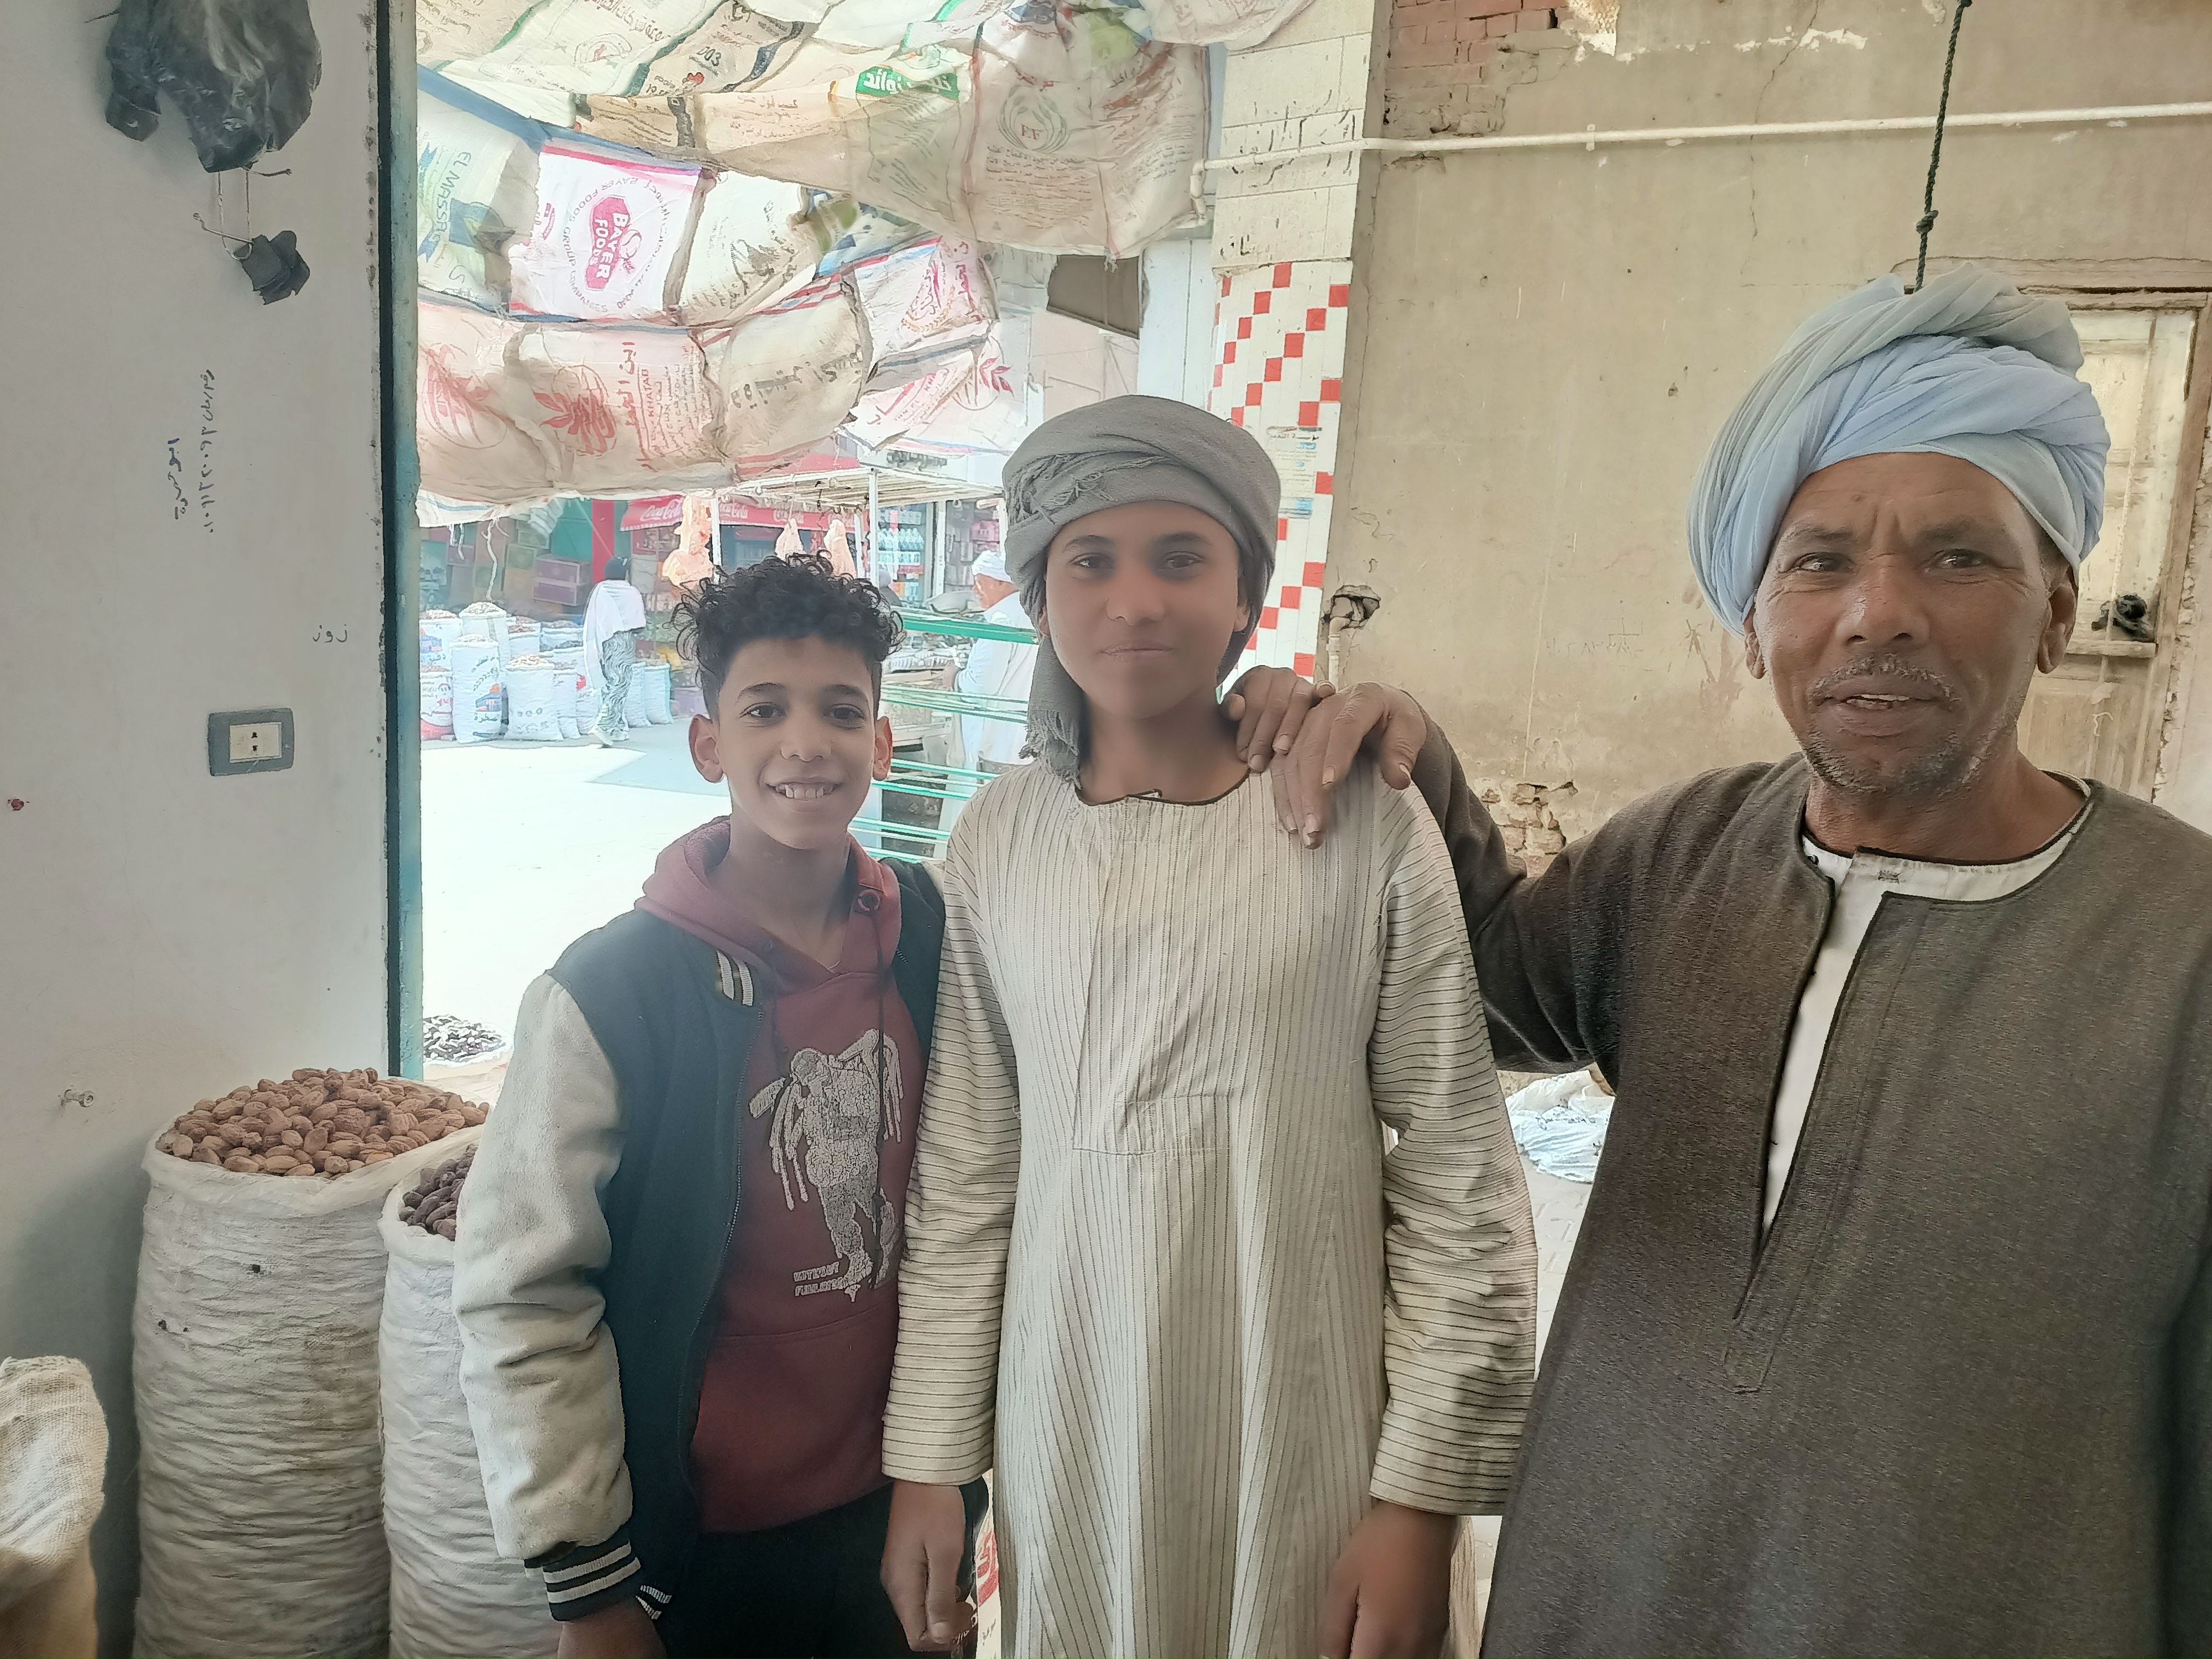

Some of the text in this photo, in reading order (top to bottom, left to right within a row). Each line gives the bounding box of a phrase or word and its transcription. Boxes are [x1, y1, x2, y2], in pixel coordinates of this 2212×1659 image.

[453, 151, 472, 168] EL
[588, 218, 609, 266] FOODS
[596, 212, 629, 278] BAYER
[793, 1261, 839, 1282] WITHOUT
